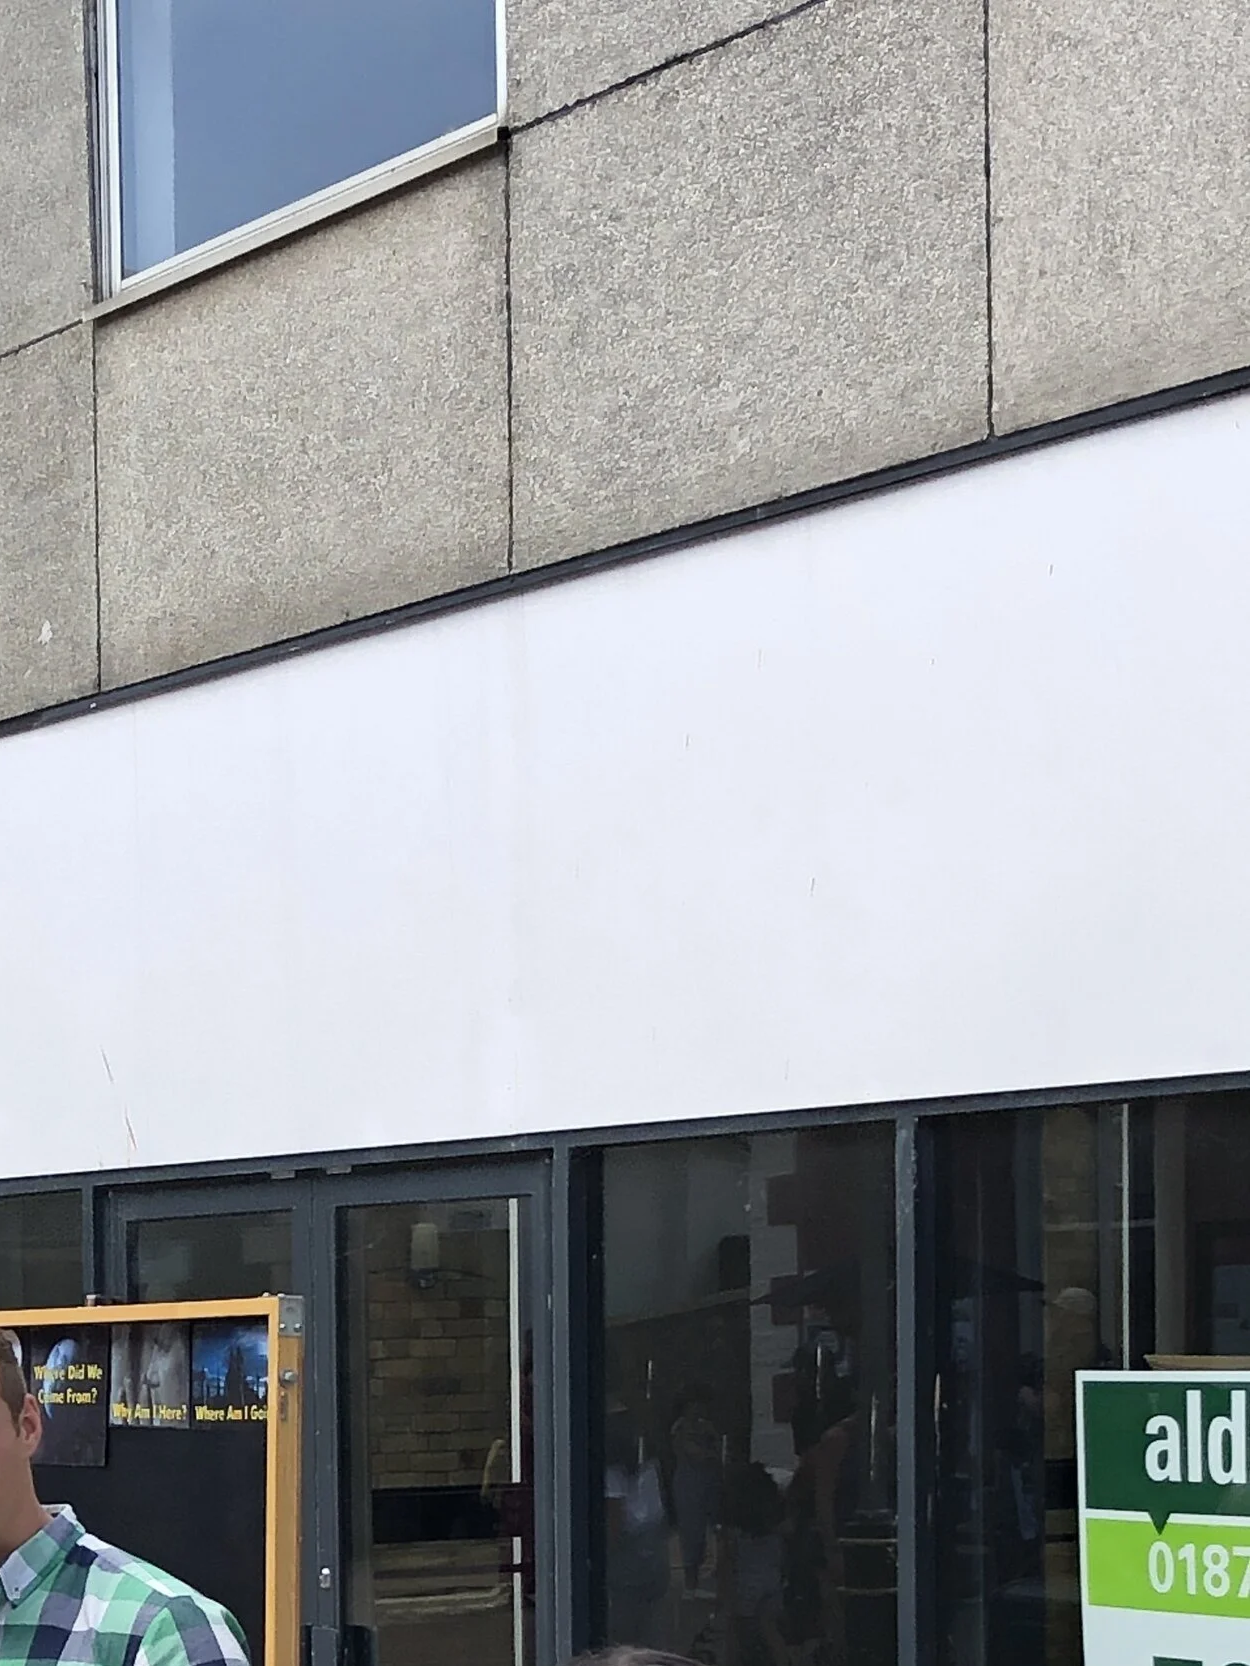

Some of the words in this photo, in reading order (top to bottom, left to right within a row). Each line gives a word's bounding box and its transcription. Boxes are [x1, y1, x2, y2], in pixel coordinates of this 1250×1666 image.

[67, 1364, 86, 1380] Did
[87, 1364, 103, 1380] We
[134, 1403, 150, 1419] Am
[226, 1405, 243, 1420] Am
[1145, 1389, 1247, 1485] ald
